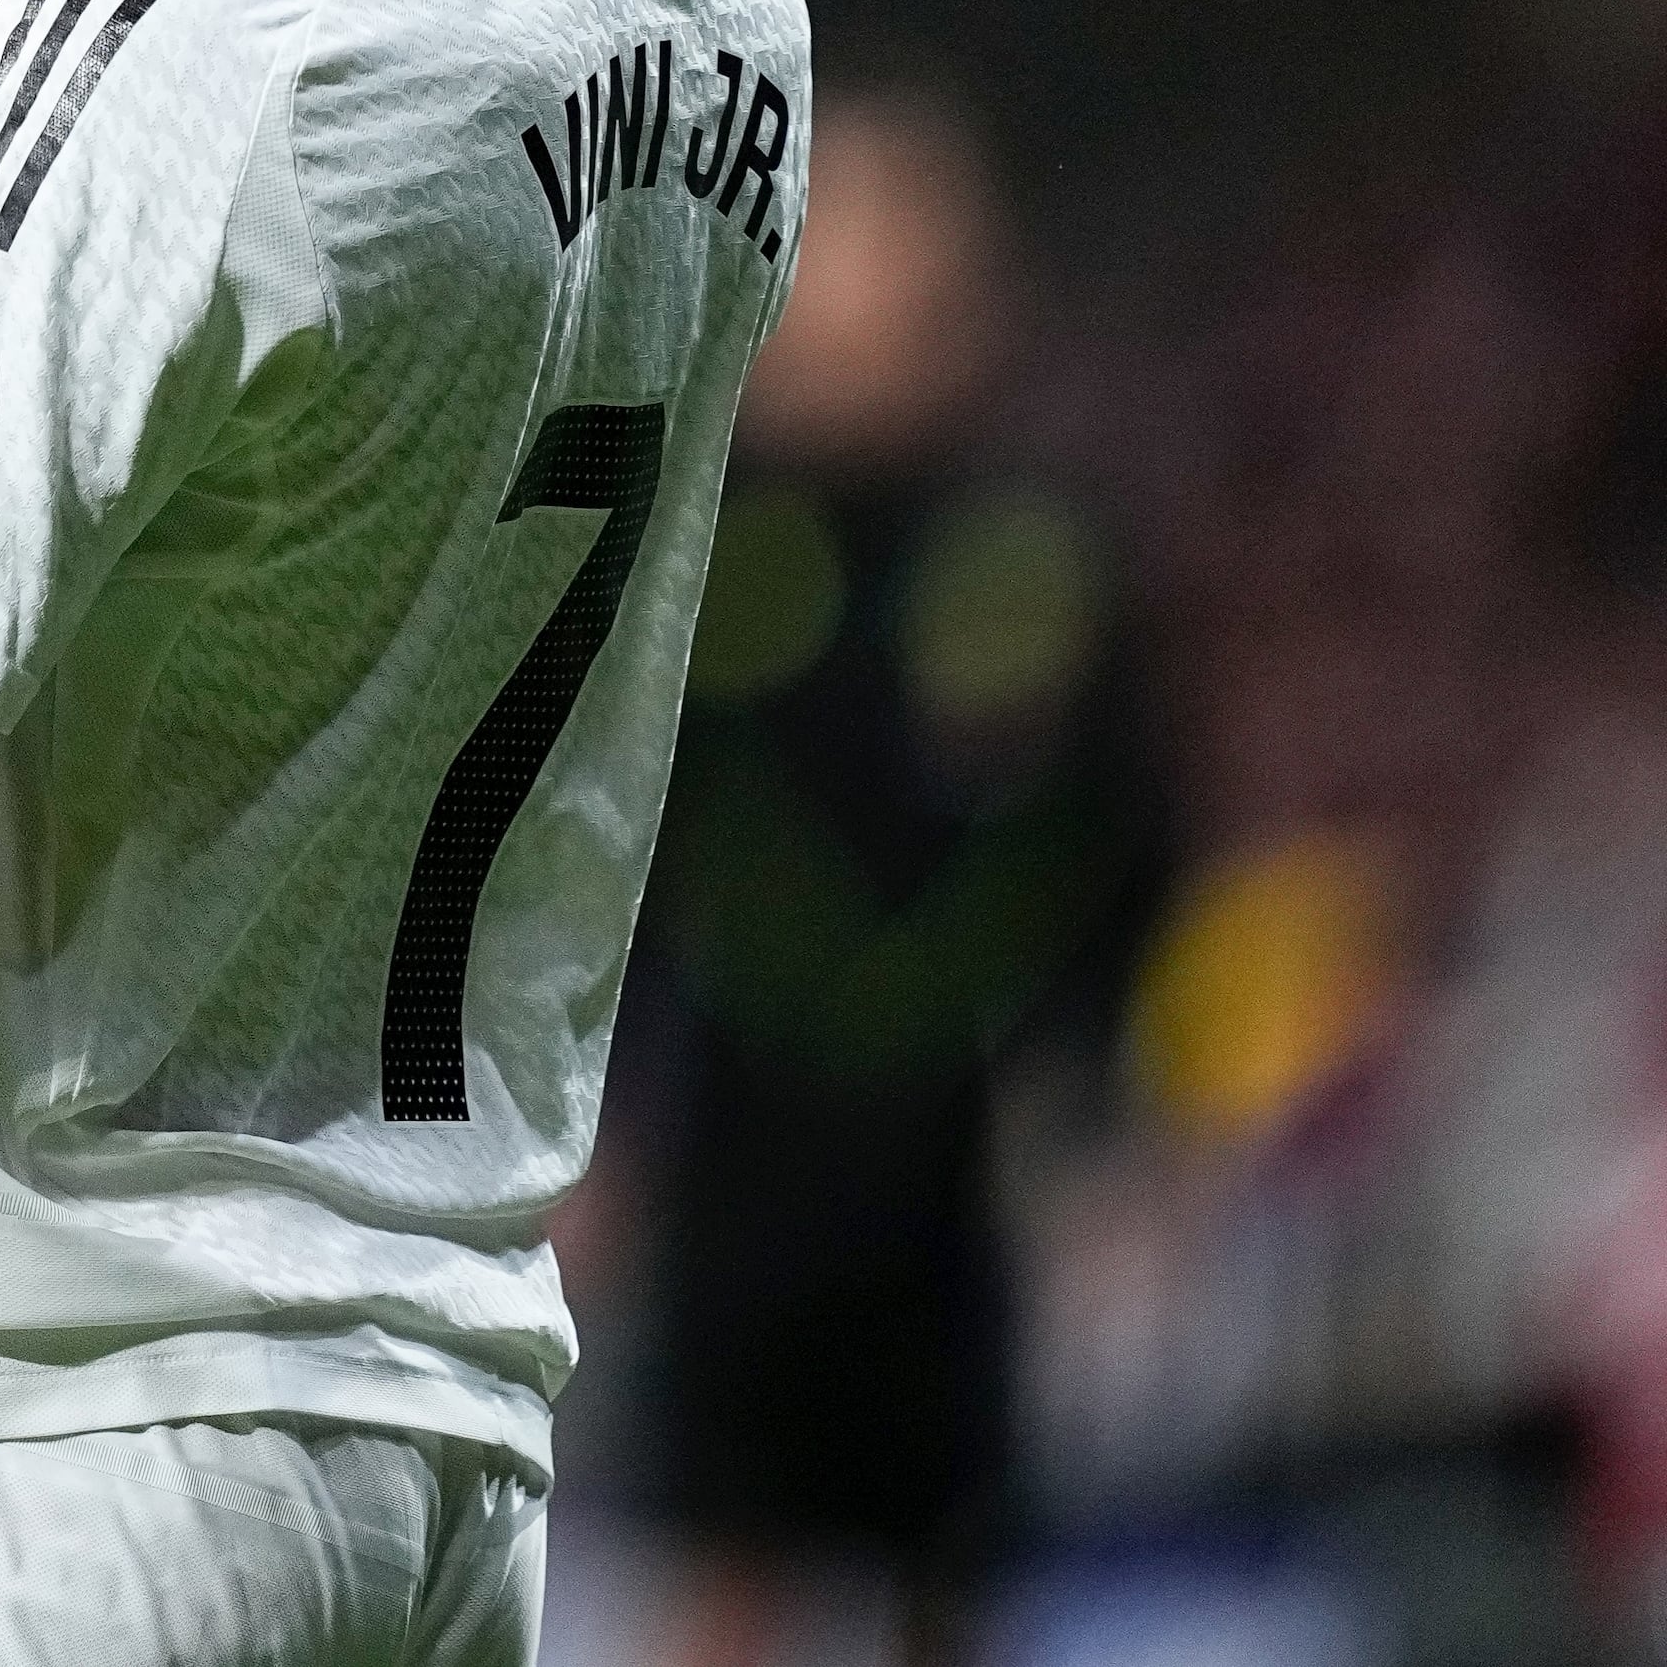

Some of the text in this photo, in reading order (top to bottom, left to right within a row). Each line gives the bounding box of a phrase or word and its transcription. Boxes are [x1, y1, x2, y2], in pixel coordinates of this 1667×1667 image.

[521, 40, 789, 264] VINI JR.
[381, 402, 665, 1121] 7
